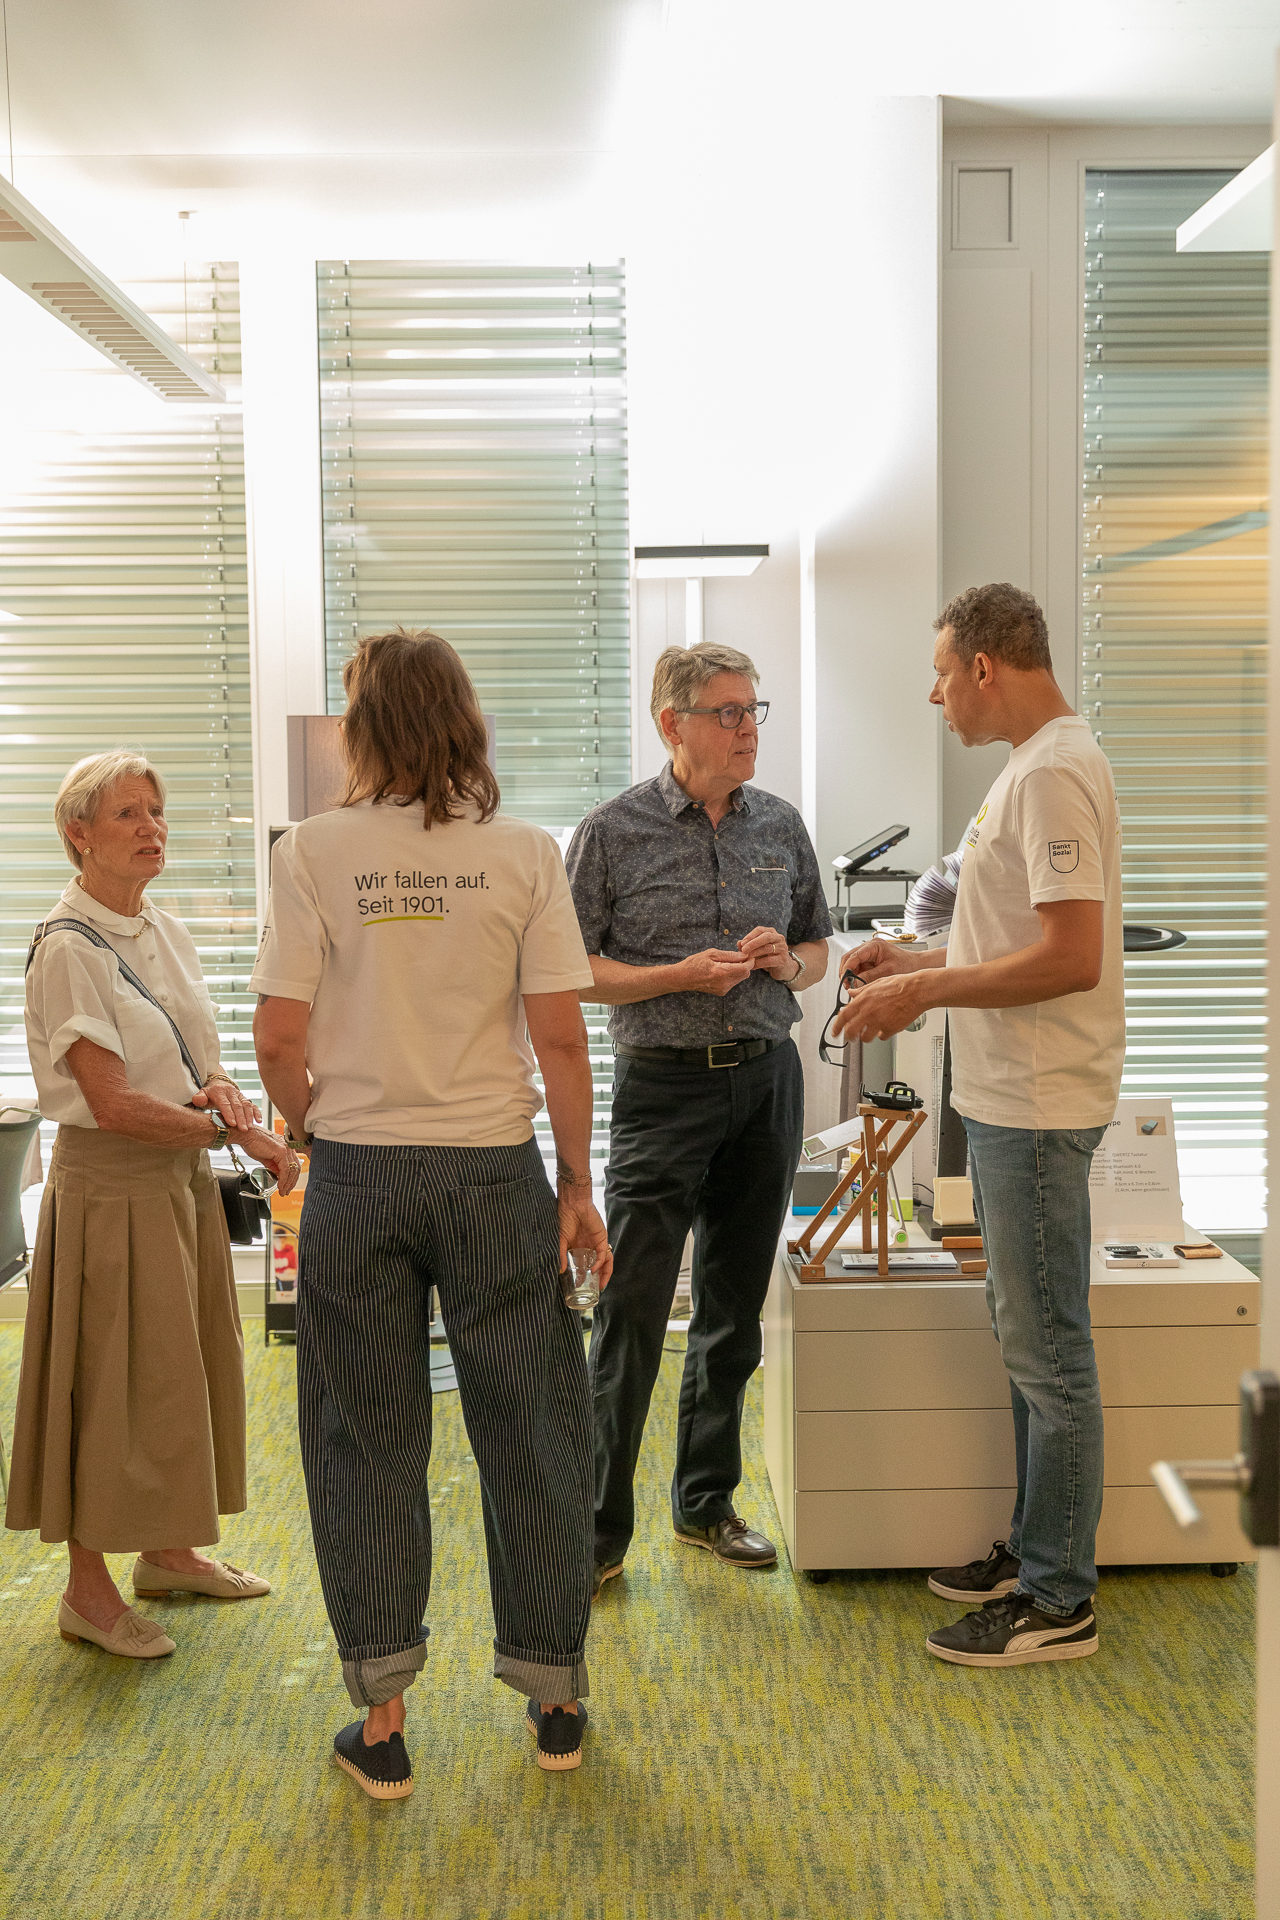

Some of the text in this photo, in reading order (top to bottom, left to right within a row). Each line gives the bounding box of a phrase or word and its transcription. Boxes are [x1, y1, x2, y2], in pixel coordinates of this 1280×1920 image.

[354, 871, 490, 891] Wir fallen auf.
[357, 895, 450, 915] Seit 1901.
